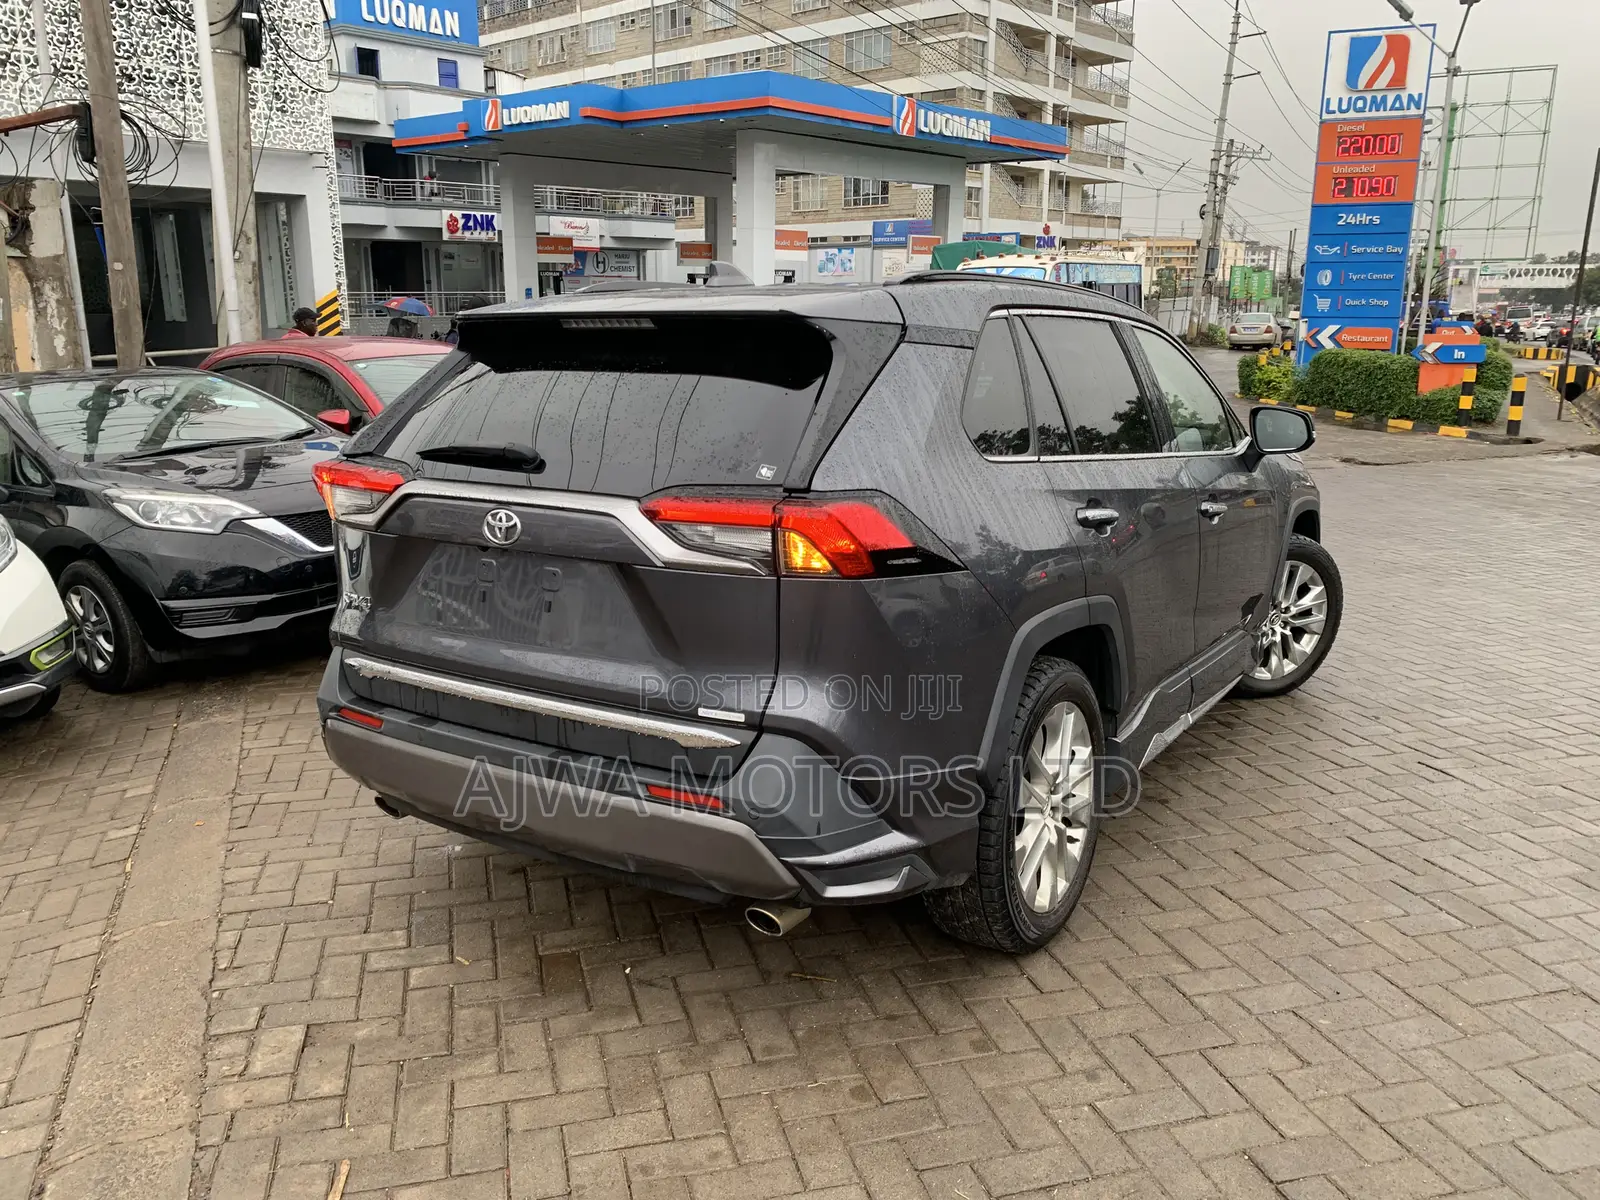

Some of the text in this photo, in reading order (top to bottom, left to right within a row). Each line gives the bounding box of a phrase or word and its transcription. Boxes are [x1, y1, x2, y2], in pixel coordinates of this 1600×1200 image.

[361, 0, 460, 38] LUQMAN
[1325, 92, 1423, 115] LUQMAN
[502, 100, 570, 126] LUQMAN
[918, 108, 991, 142] LUQMAN
[1337, 124, 1365, 133] Diesel
[1338, 134, 1399, 156] 220.00
[1333, 165, 1376, 174] Unleaded
[461, 213, 496, 232] ZNK
[1337, 213, 1380, 225] 24Hrs
[1036, 235, 1057, 248] ZNK
[1351, 244, 1404, 255] Service Bay
[609, 264, 636, 273] CHEMIST
[1348, 272, 1395, 283] Tyre Center
[1369, 298, 1389, 308] Shop
[1341, 333, 1389, 343] Restaurant
[1453, 348, 1466, 360] In
